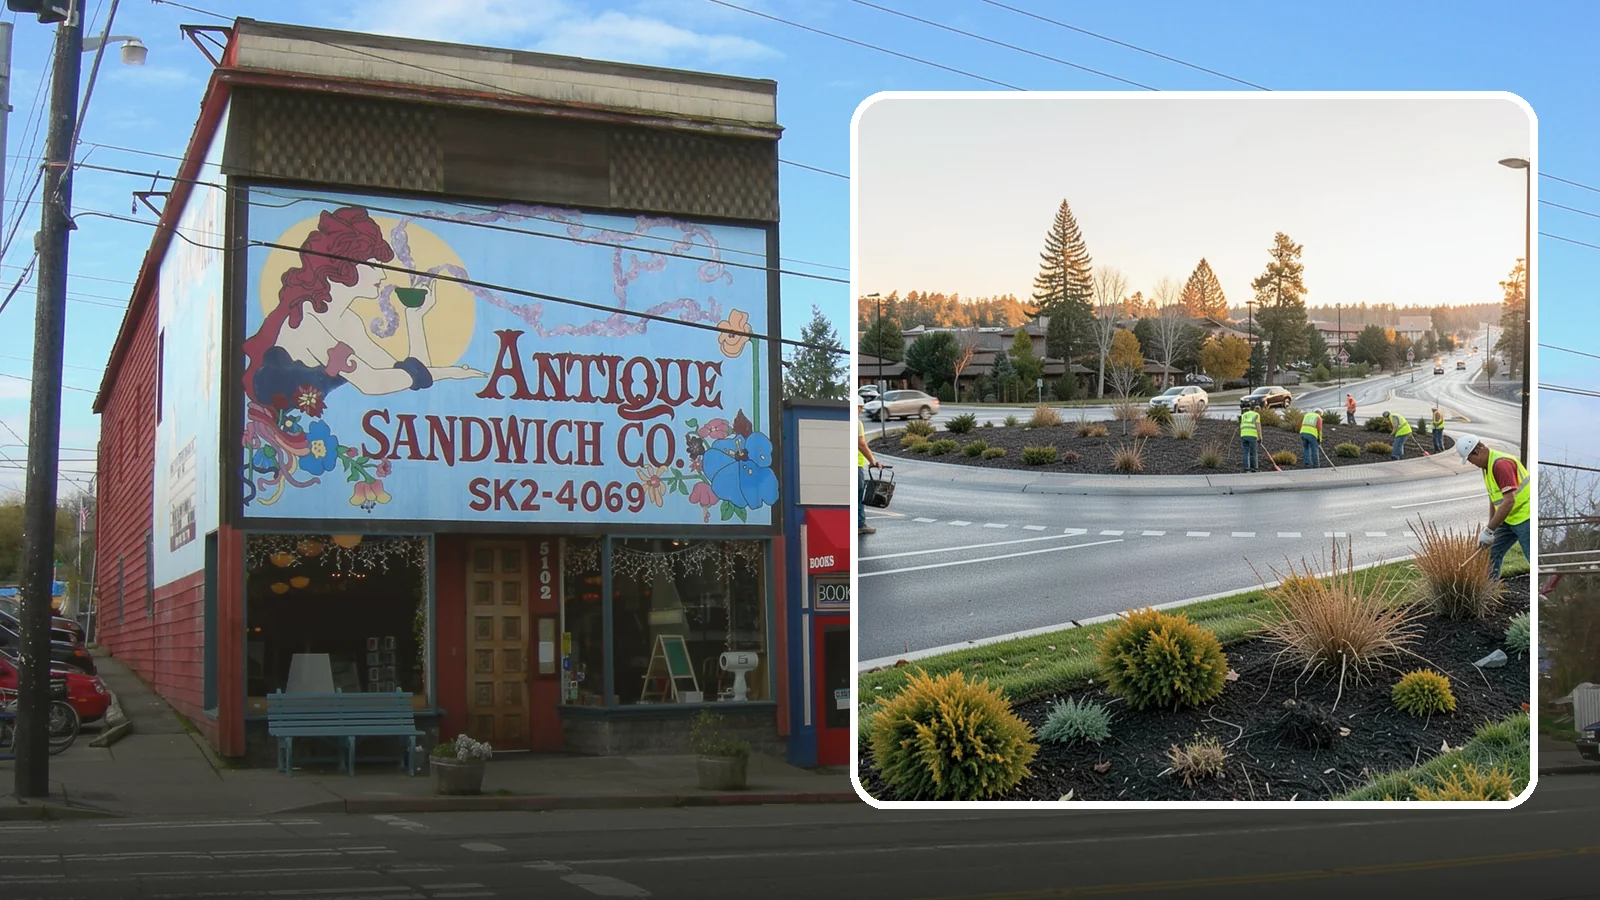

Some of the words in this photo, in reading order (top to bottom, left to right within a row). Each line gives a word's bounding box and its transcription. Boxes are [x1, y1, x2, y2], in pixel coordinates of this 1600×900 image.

[475, 329, 723, 420] ANTIQUE
[361, 409, 604, 467] SANDWICH
[616, 421, 685, 469] CO.
[468, 477, 645, 513] SK2-4069
[540, 541, 551, 600] 5102
[809, 555, 835, 569] BOOKS
